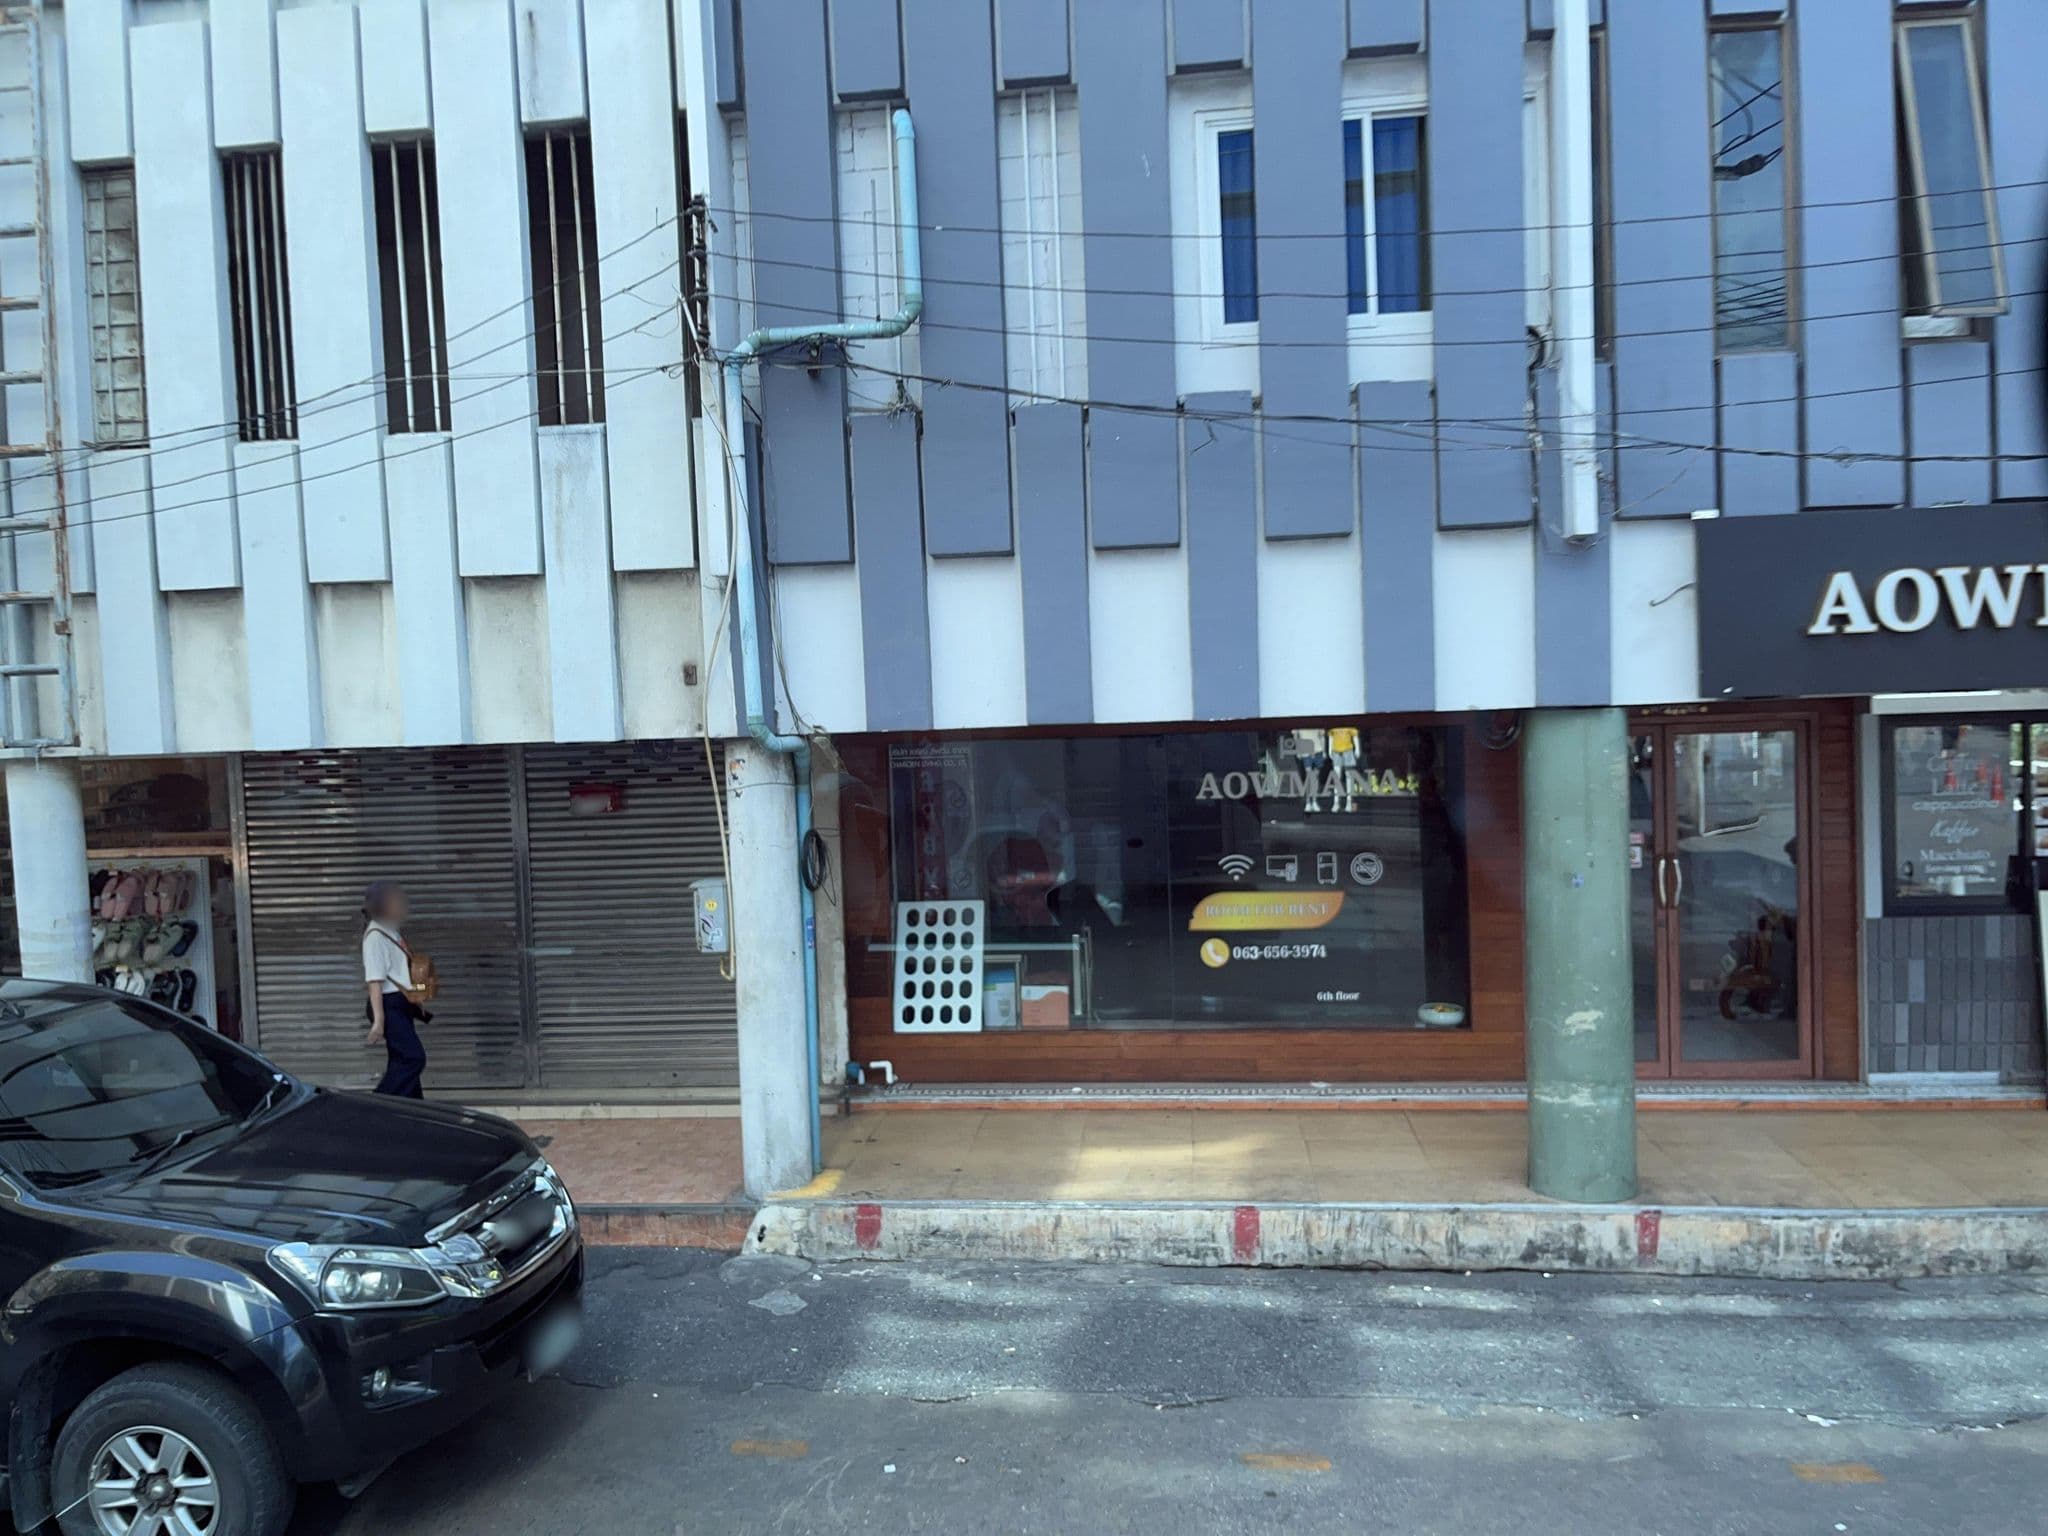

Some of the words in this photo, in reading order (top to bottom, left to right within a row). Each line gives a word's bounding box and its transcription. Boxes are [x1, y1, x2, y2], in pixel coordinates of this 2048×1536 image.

[1807, 564, 2048, 635] AOW
[1196, 769, 1417, 799] AOWMANA
[1289, 903, 1328, 915] RENT
[1336, 990, 1360, 1001] floor
